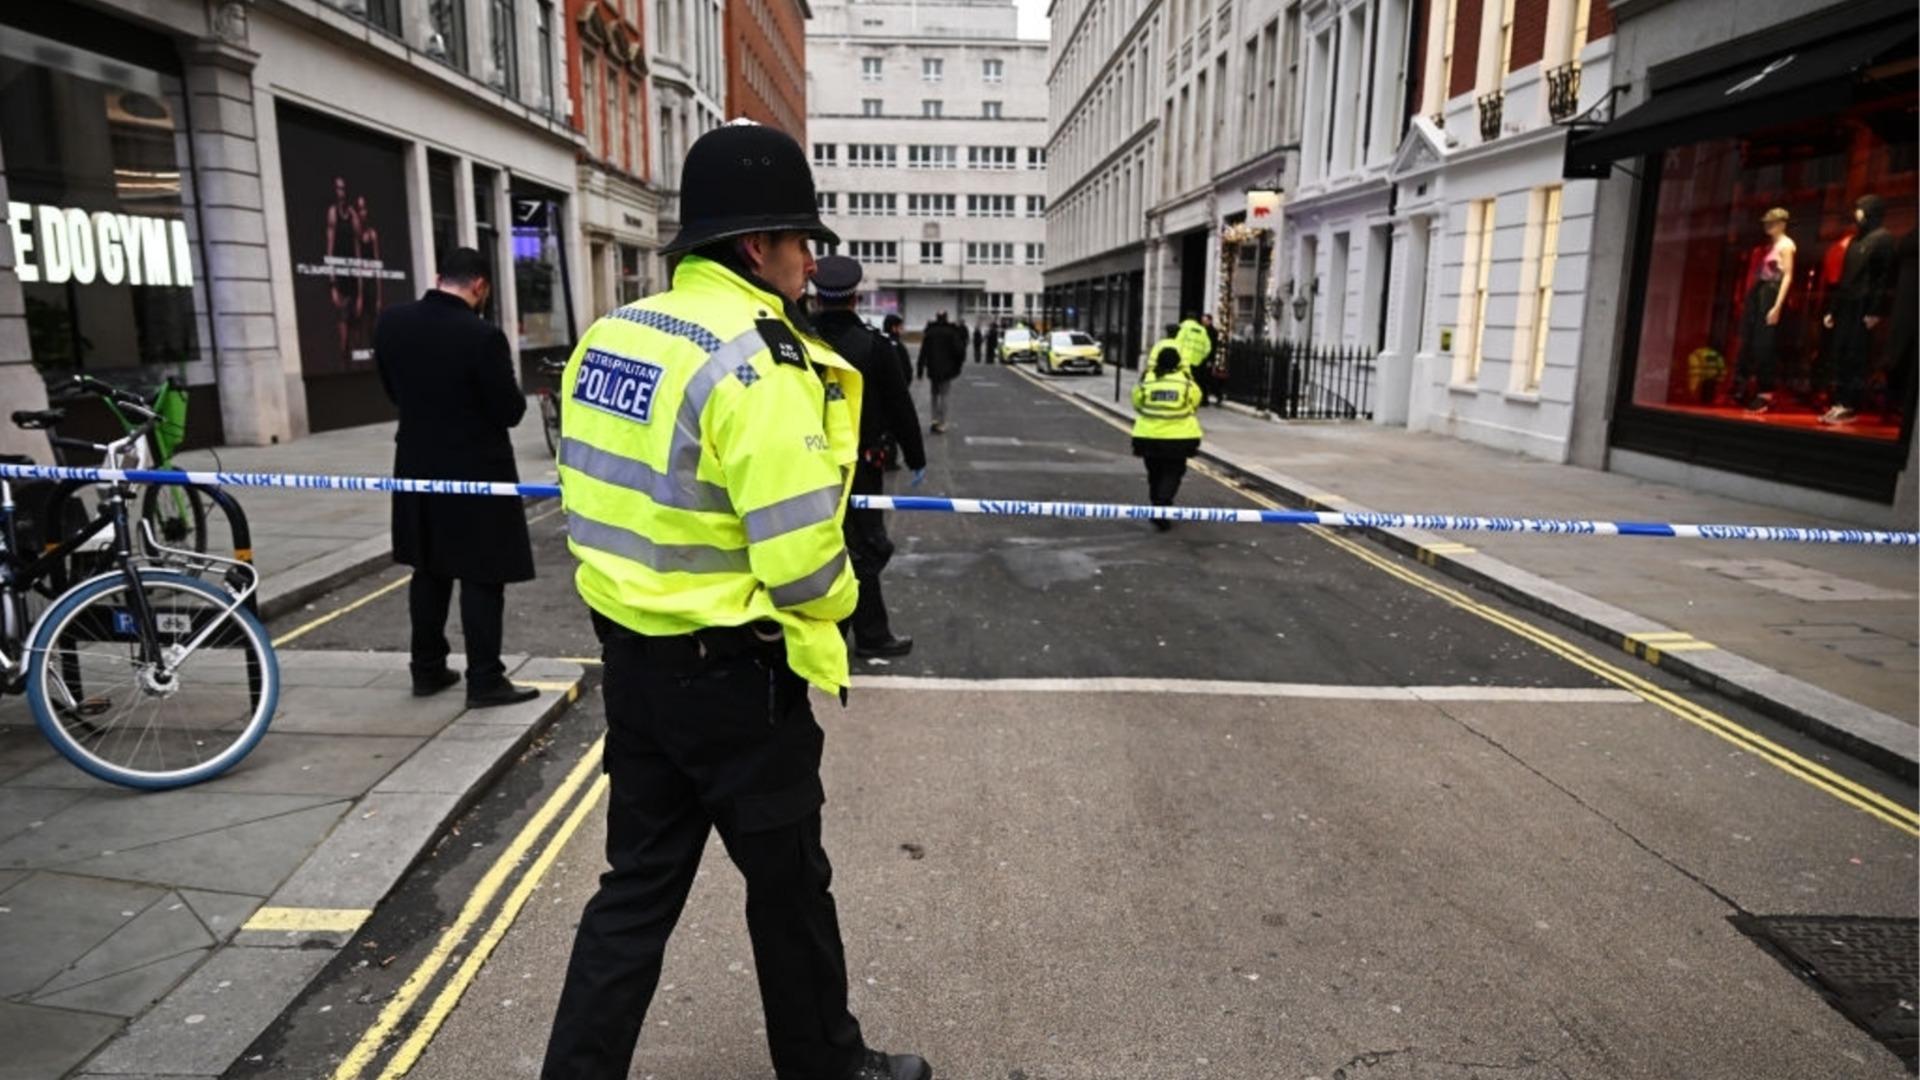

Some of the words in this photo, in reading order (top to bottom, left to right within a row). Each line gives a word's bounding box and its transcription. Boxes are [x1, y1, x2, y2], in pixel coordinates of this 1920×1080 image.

[38, 205, 96, 285] DO
[95, 211, 172, 286] GYM
[574, 365, 654, 416] POLICE
